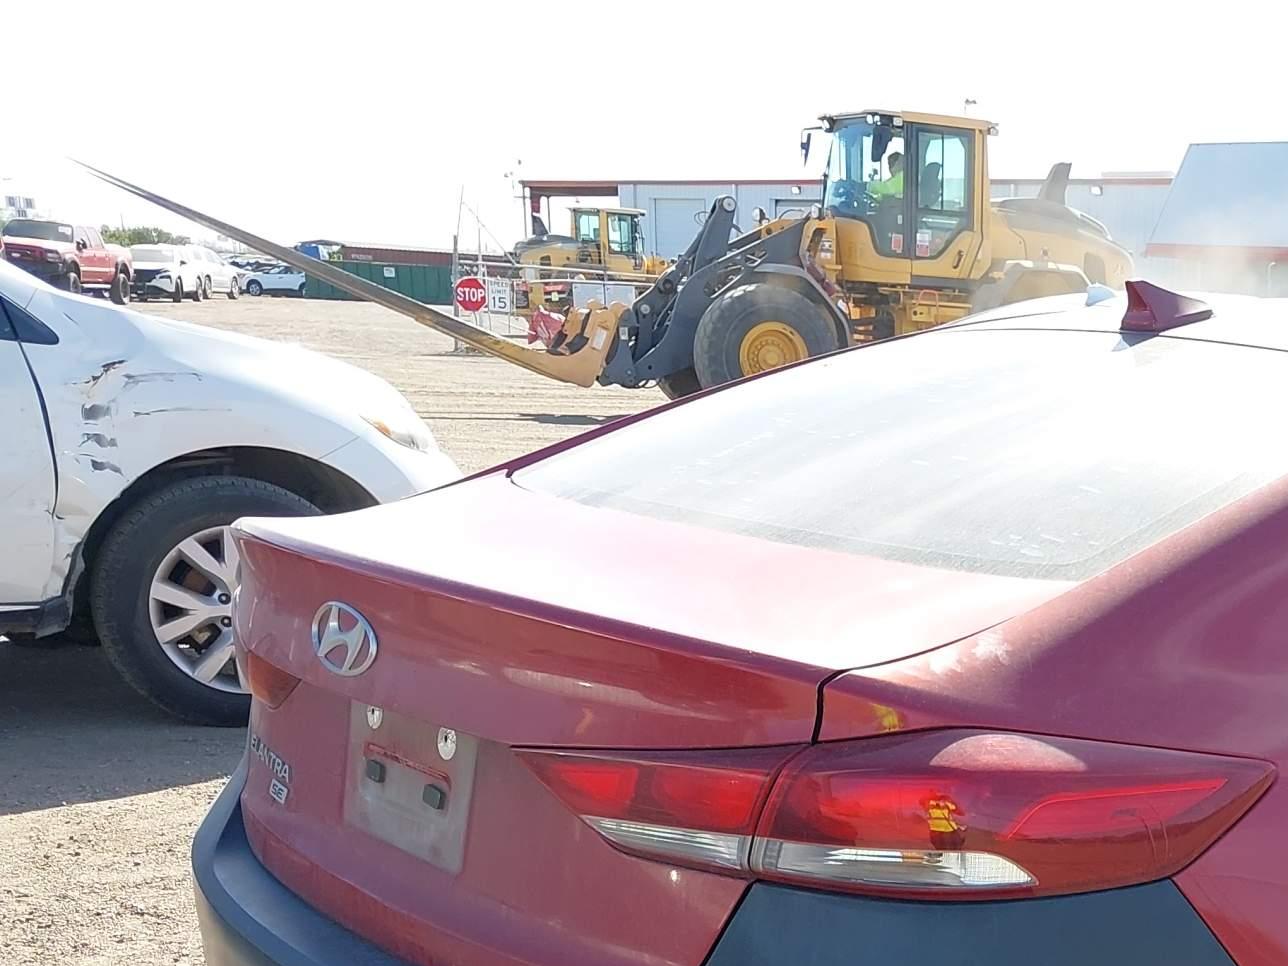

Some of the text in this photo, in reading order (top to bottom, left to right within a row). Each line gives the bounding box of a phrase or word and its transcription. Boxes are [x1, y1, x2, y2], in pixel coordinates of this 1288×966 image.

[456, 287, 485, 303] STOP
[492, 296, 507, 309] 15
[251, 734, 289, 784] ELANTRA
[270, 783, 286, 801] SE
